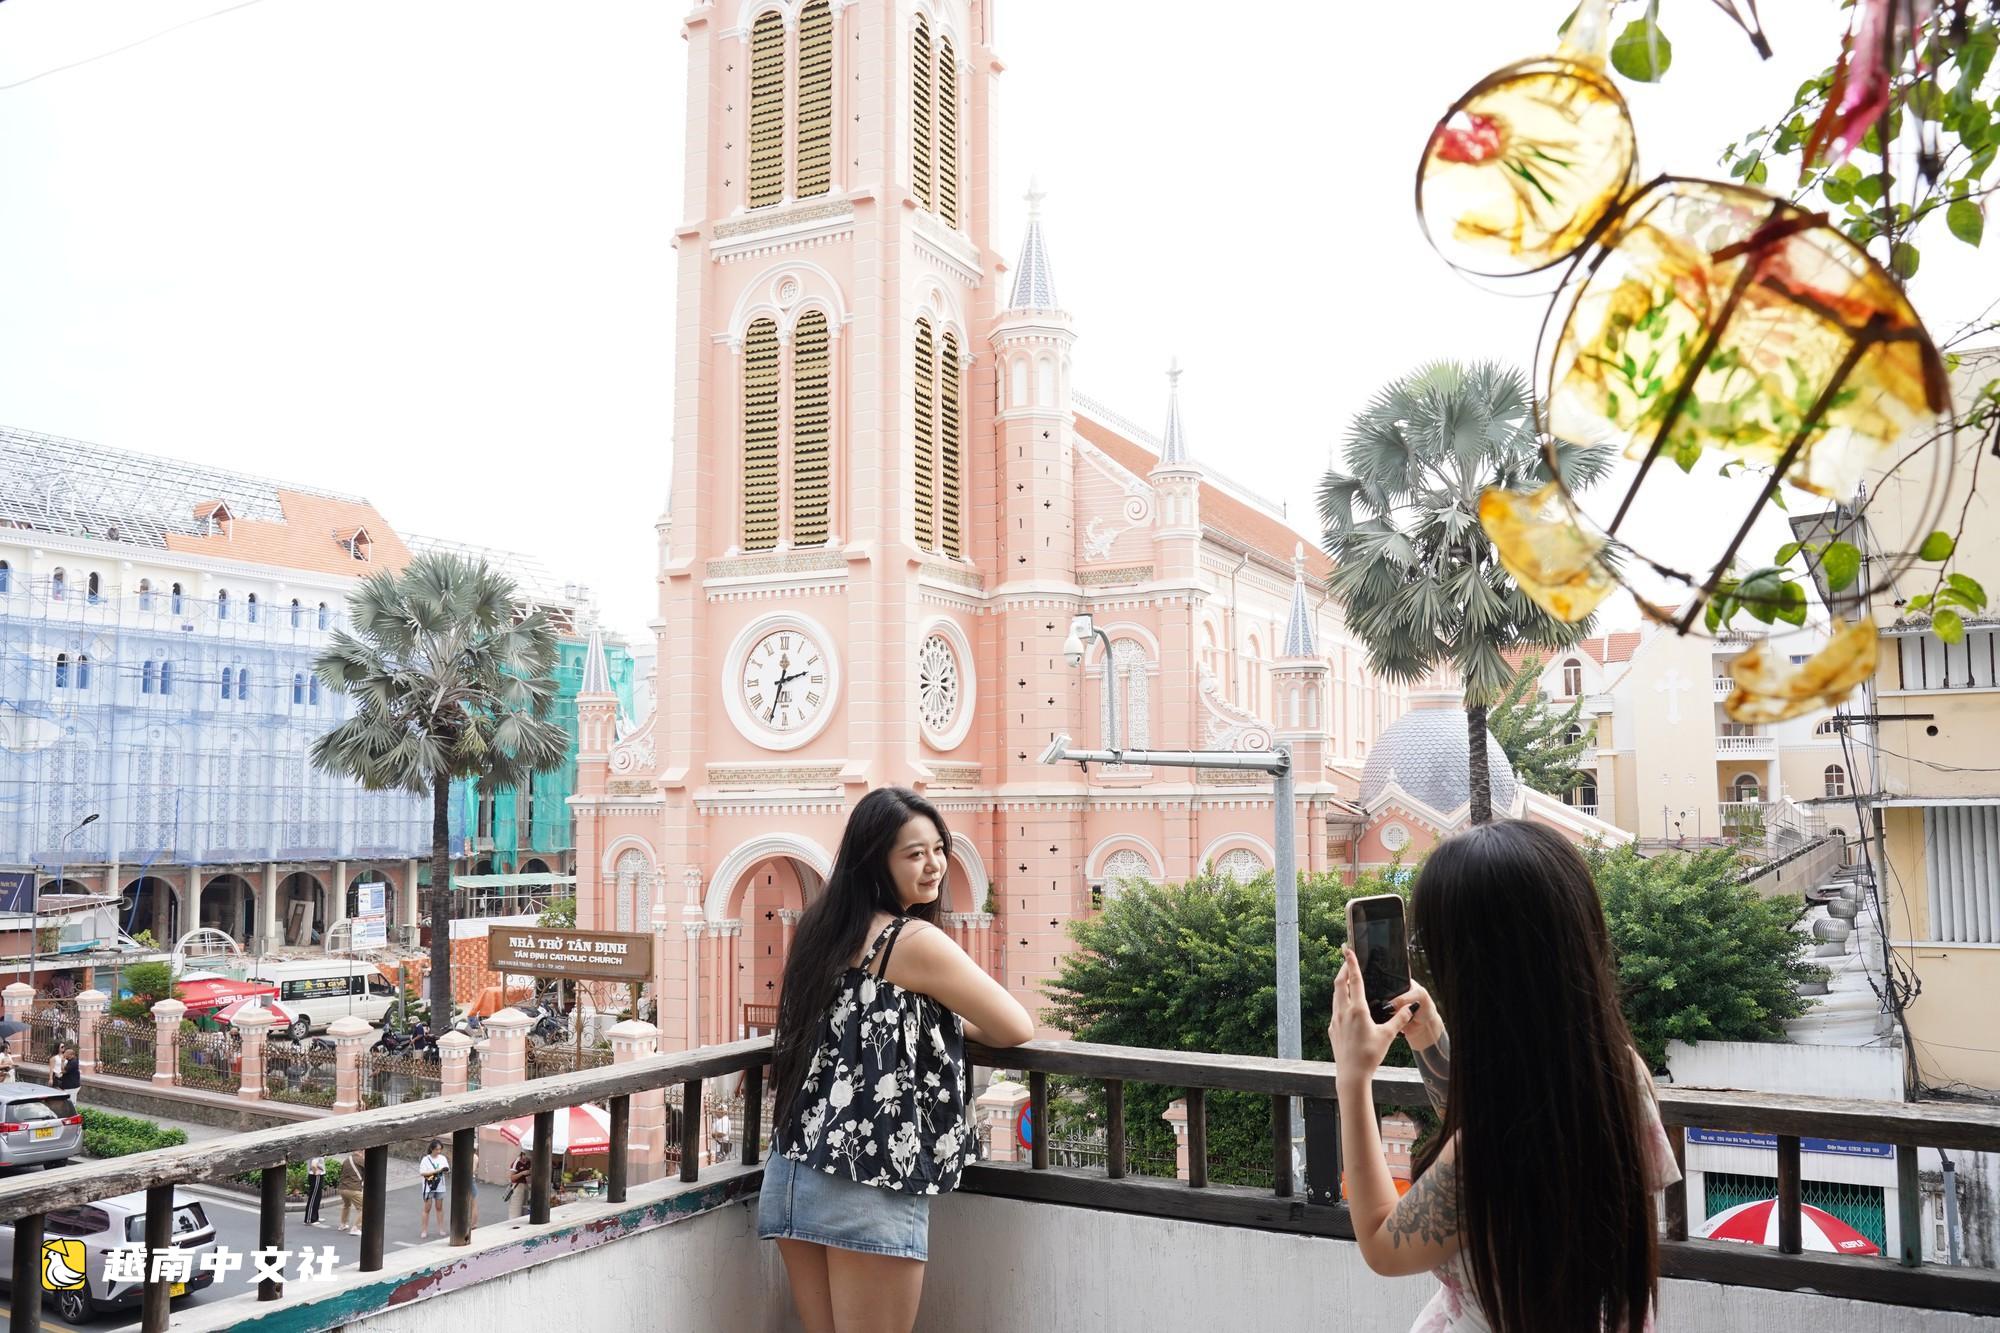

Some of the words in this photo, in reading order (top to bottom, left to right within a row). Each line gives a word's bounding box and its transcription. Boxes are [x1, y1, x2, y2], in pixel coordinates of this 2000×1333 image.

[509, 935, 536, 949] NHÀ
[538, 937, 564, 950] THỜ
[567, 939, 592, 952] TÂN
[595, 942, 628, 955] ĐỊNH
[514, 950, 529, 958] TÂN
[529, 952, 548, 961] ĐỊNH
[549, 953, 588, 963] CATHOLIC
[589, 956, 623, 965] CHURCH
